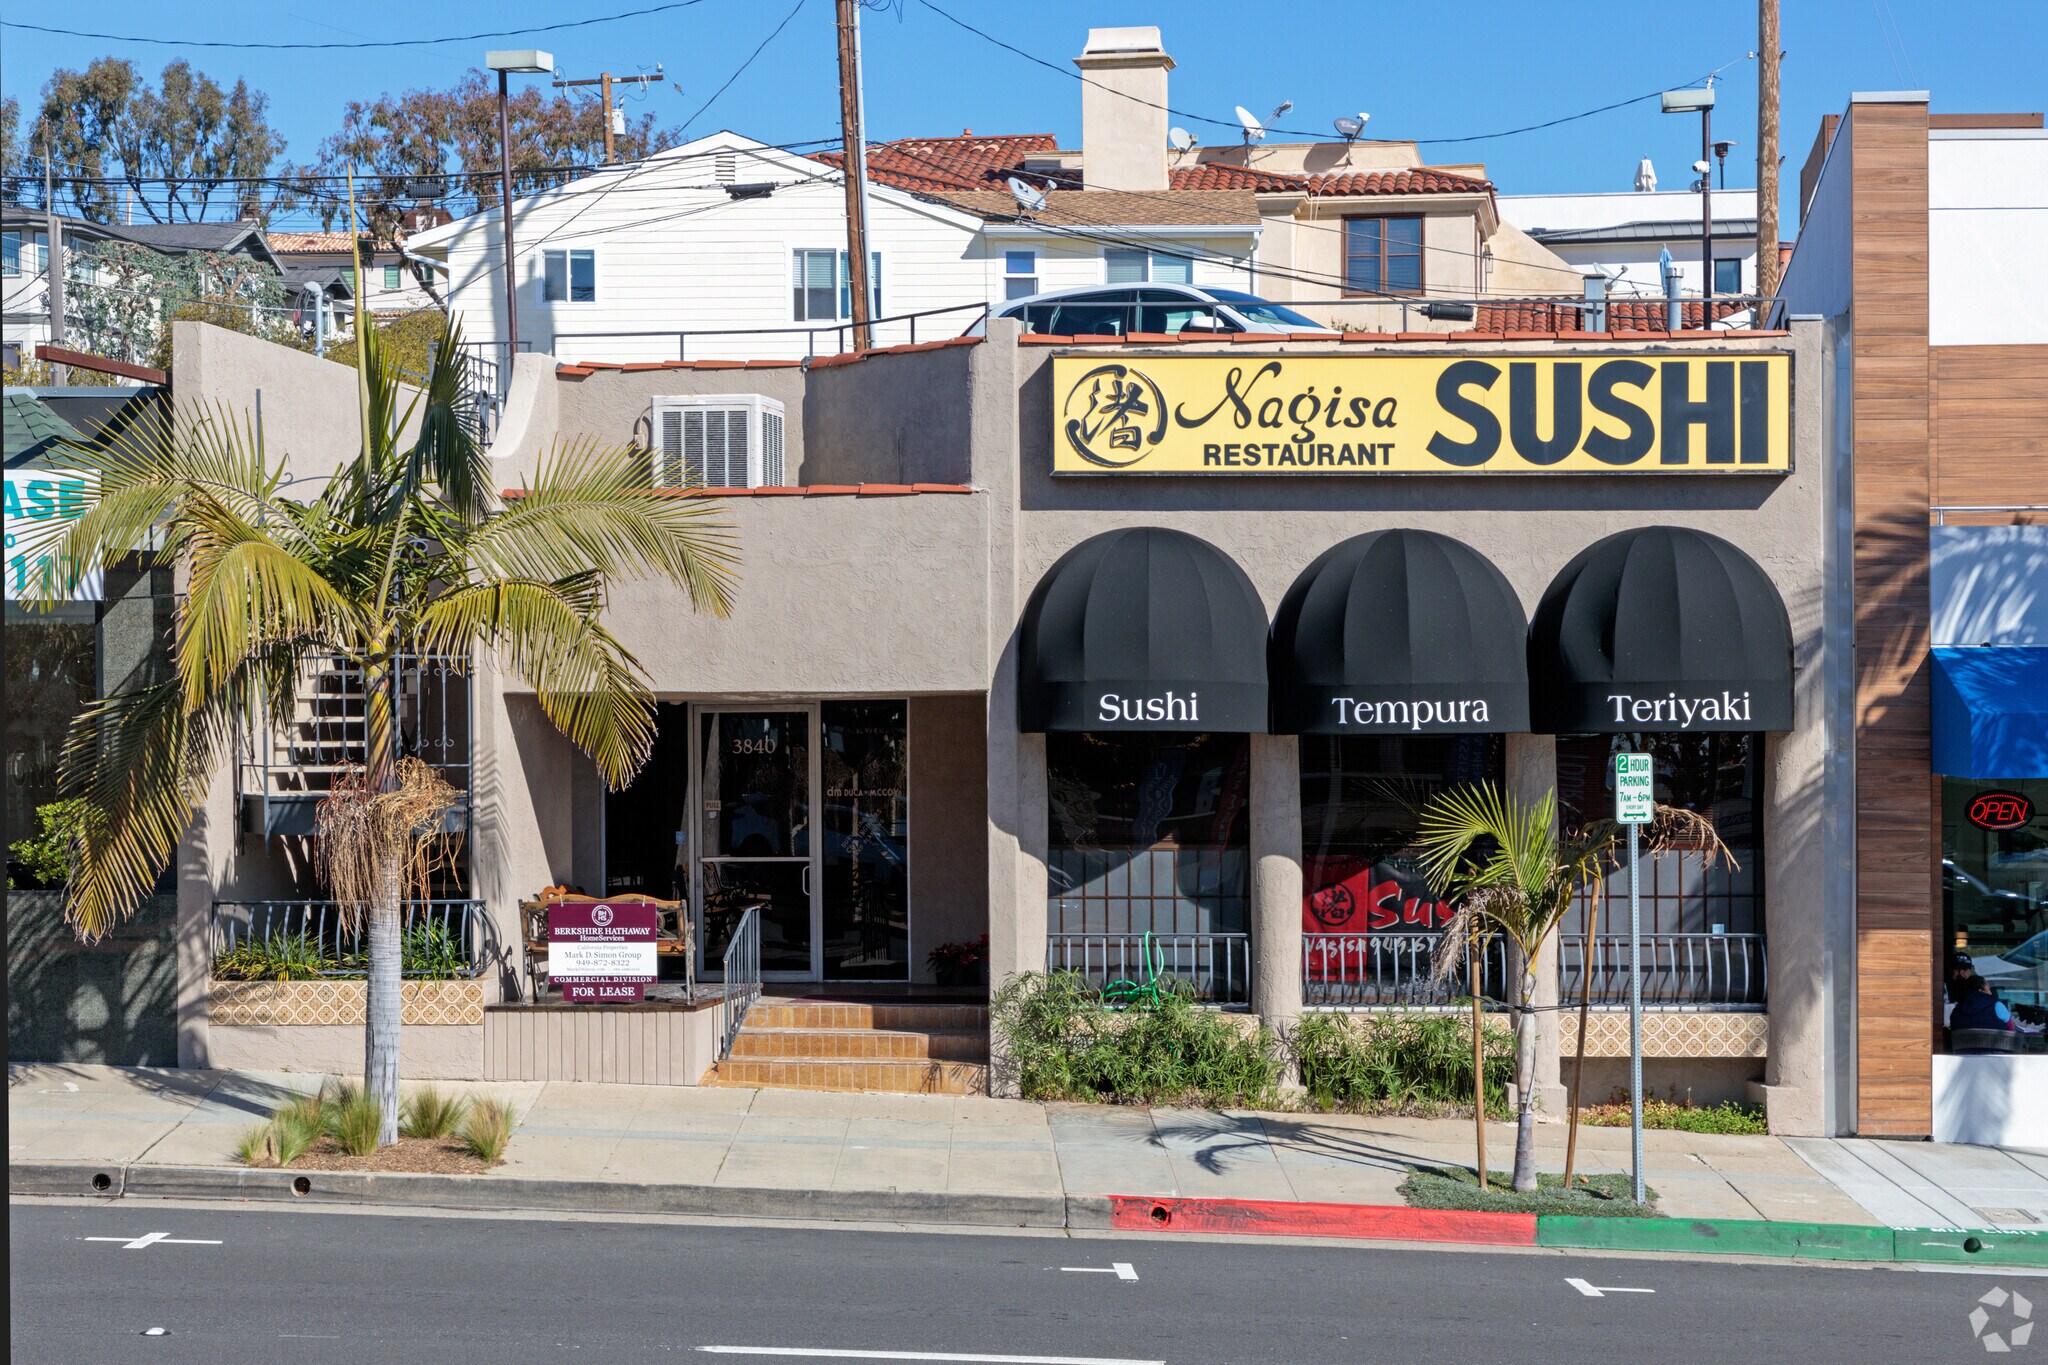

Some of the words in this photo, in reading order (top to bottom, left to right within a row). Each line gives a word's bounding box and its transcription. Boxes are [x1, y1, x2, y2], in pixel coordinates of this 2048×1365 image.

[1174, 361, 1398, 443] Nagisa
[1426, 360, 1769, 467] SUSHI
[1204, 443, 1396, 467] RESTAURANT
[1099, 691, 1199, 721] Sushi
[1331, 698, 1490, 731] Tempura
[1607, 691, 1751, 728] Teriyaki
[732, 739, 776, 754] 3840
[1619, 756, 1627, 771] 2
[1630, 759, 1649, 771] HOUR
[1620, 776, 1649, 787] PARKING
[1619, 791, 1631, 802] 7AM
[1638, 791, 1650, 802] 6PM
[1970, 801, 2028, 821] OPEN
[554, 927, 604, 935] BERKSHIRE
[605, 927, 651, 935] HATHAWAY
[618, 952, 642, 960] Group
[572, 987, 596, 997] FOR
[599, 987, 636, 997] LEASE
